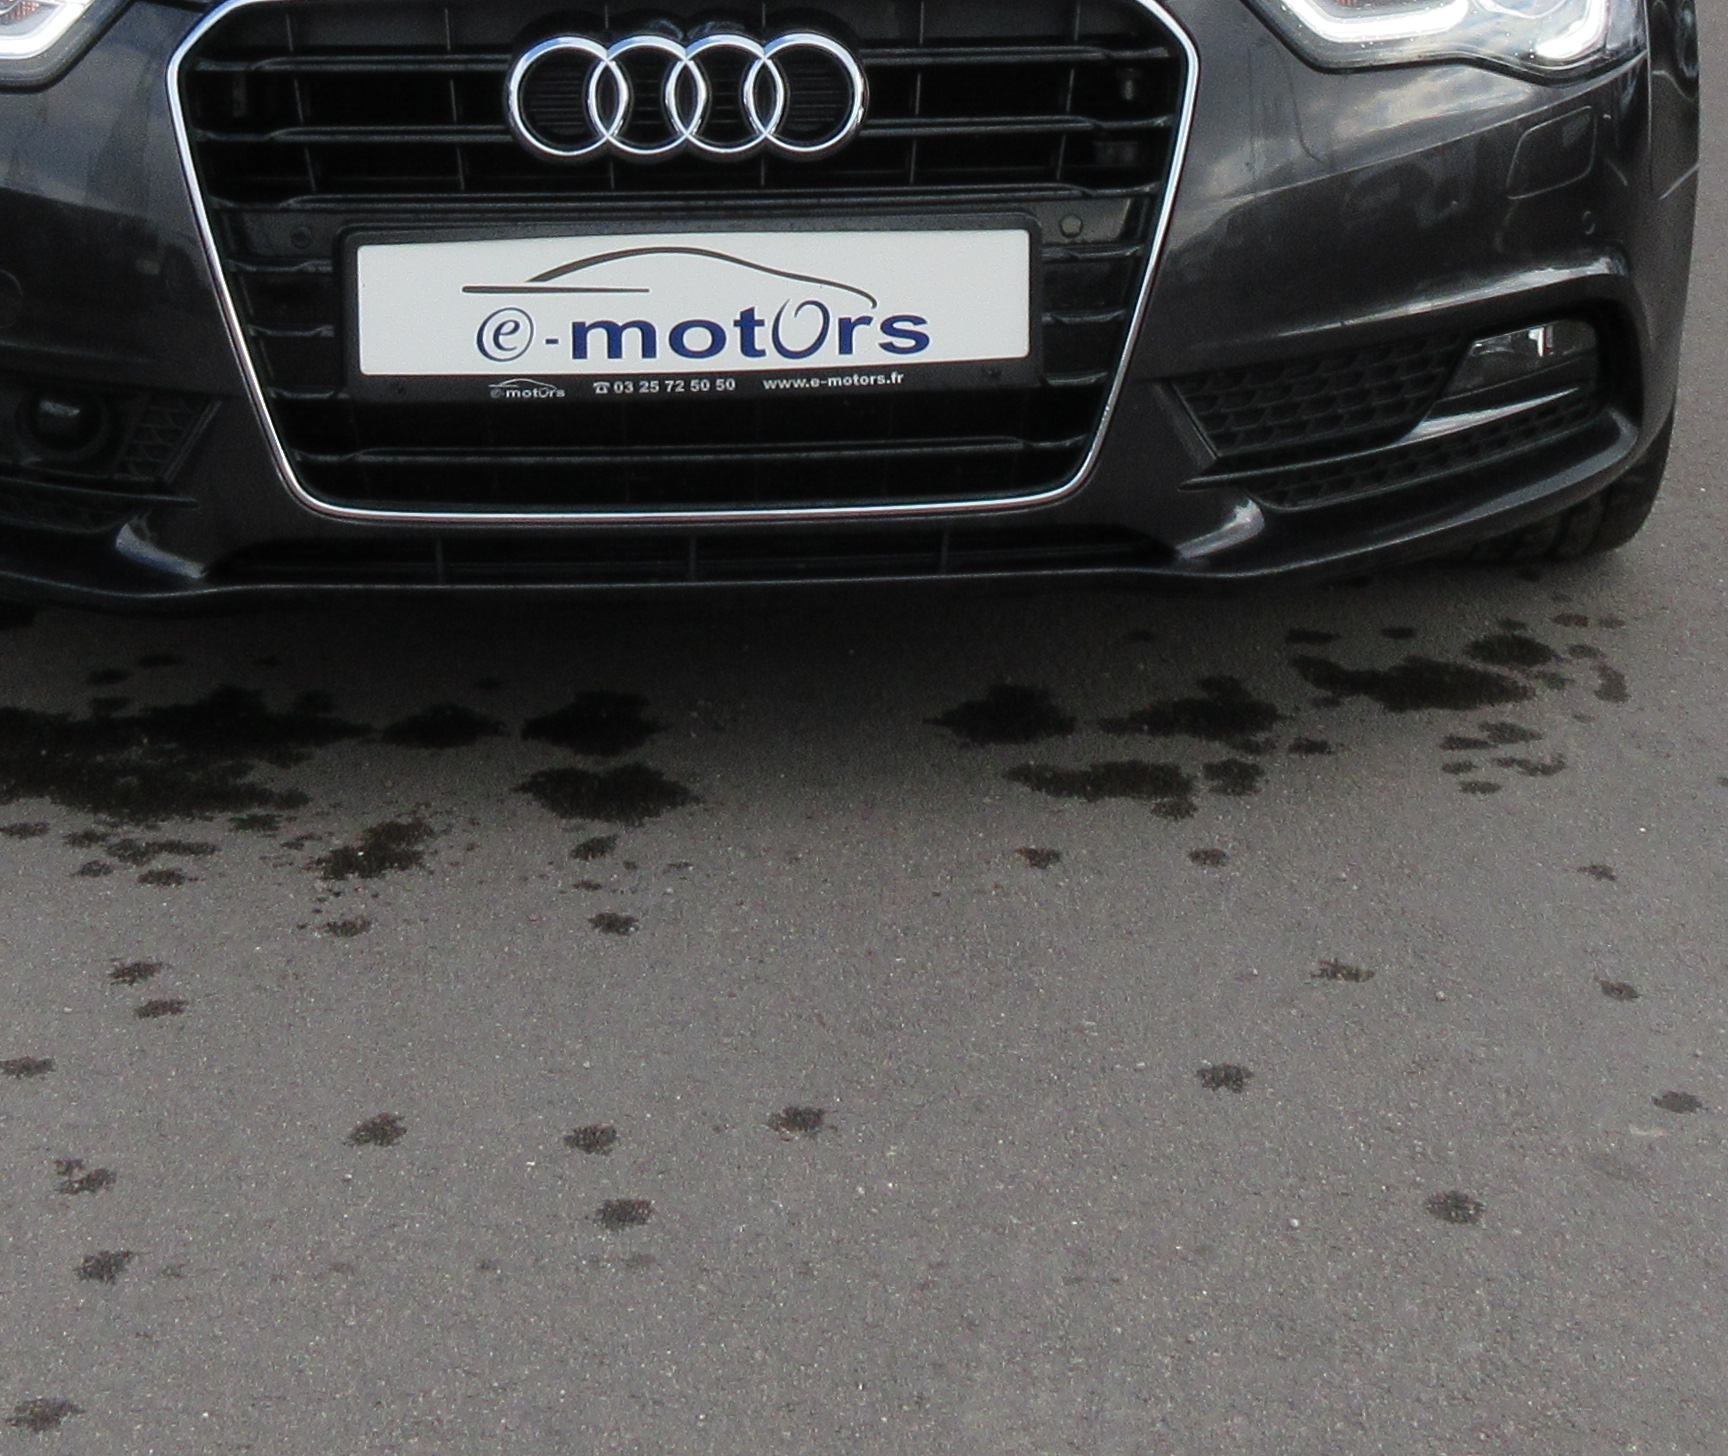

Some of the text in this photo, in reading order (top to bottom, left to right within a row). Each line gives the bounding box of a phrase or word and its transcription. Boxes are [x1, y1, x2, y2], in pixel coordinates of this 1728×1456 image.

[613, 371, 904, 394] 03 25 72 50 50 www.e-motors.fr
